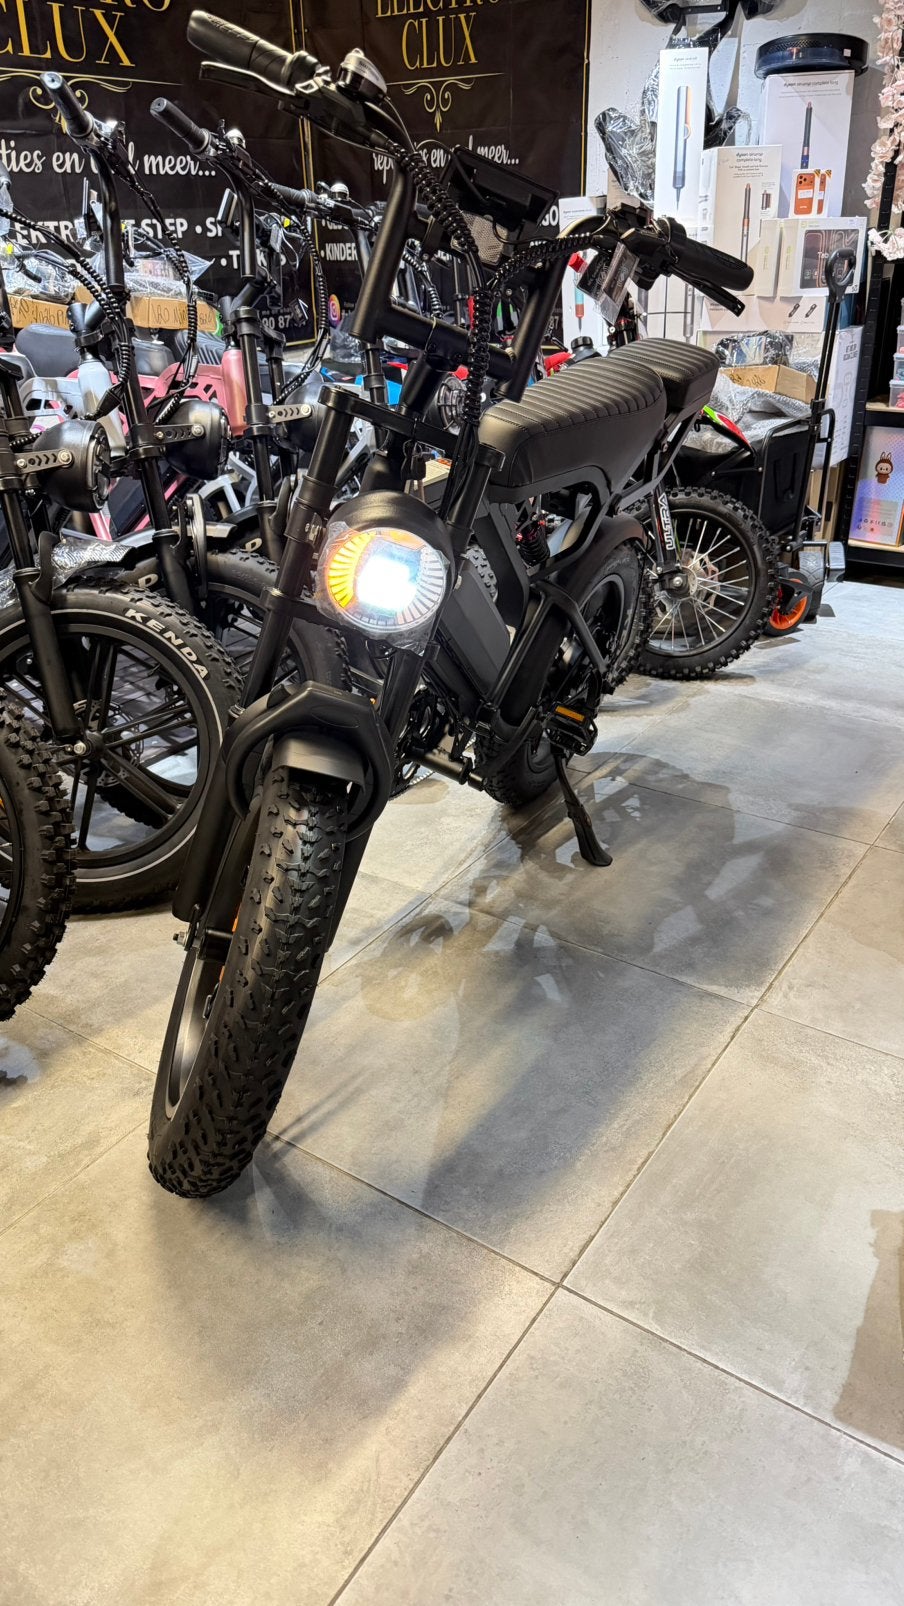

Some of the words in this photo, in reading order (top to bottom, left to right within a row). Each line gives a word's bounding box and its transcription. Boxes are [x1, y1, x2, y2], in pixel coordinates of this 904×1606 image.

[0, 0, 136, 66] LUX
[401, 12, 479, 70] CLUX
[52, 151, 85, 174] en
[143, 153, 216, 177] meer...
[430, 148, 447, 168] en
[325, 242, 359, 262] KINDER
[278, 314, 291, 329] 87
[658, 492, 677, 552] ULTRA
[125, 608, 209, 680] KENDA
